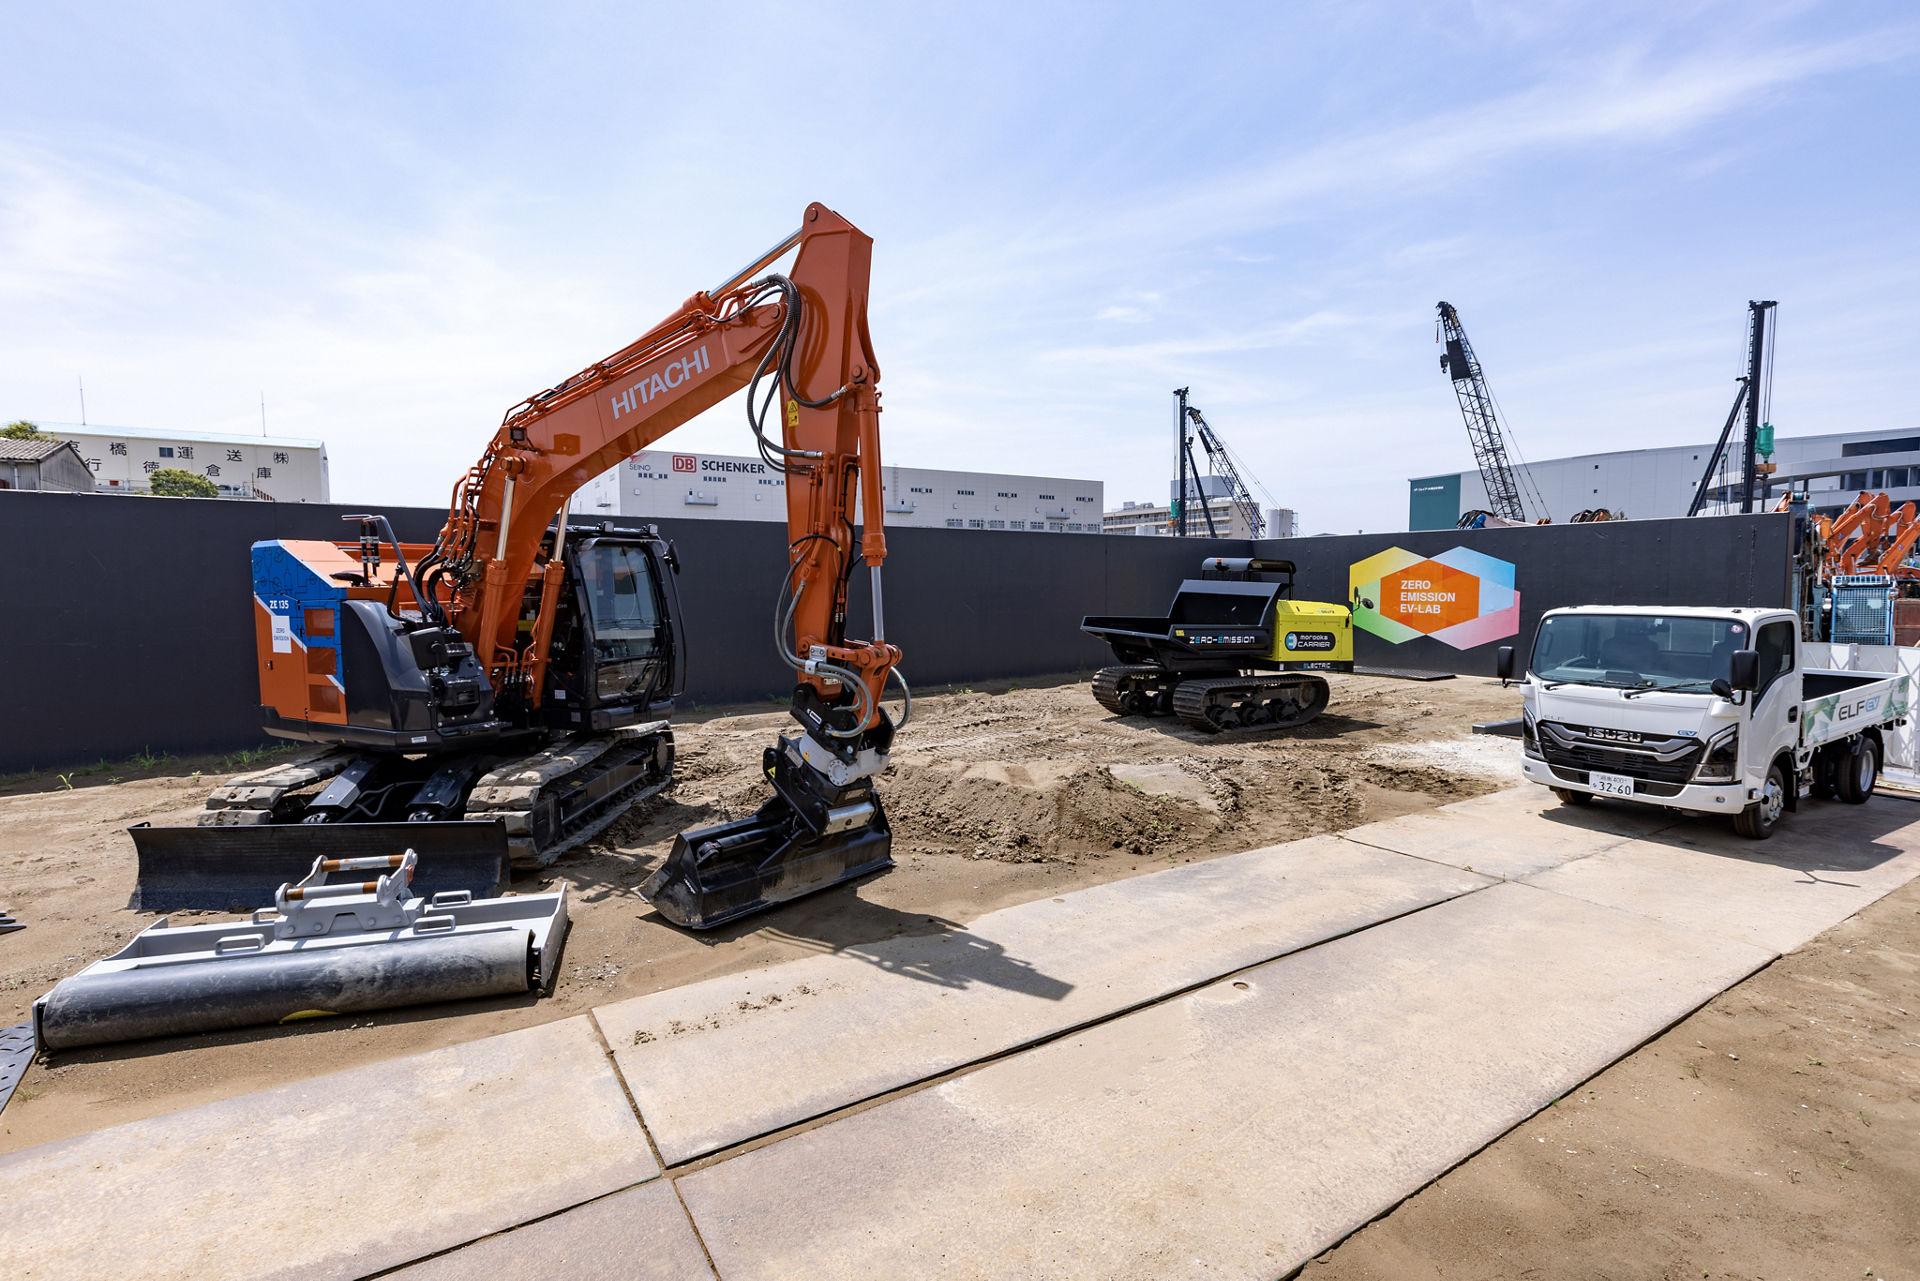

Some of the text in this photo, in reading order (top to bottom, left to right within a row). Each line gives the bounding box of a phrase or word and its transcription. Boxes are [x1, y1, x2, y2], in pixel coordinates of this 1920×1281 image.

[611, 345, 710, 420] HITACHI
[84, 457, 272, 479] 行徳倉庫
[628, 463, 651, 471] SEINO
[675, 457, 766, 474] DB SCHENKER
[1401, 580, 1431, 590] ZERO
[269, 600, 289, 609] ZE 135
[1400, 592, 1456, 602] EMISSION
[1400, 603, 1441, 614] EV-LAB
[1838, 695, 1881, 721] ELF EV
[1588, 727, 1642, 742] ISUZU
[1599, 781, 1631, 796] 32-60
